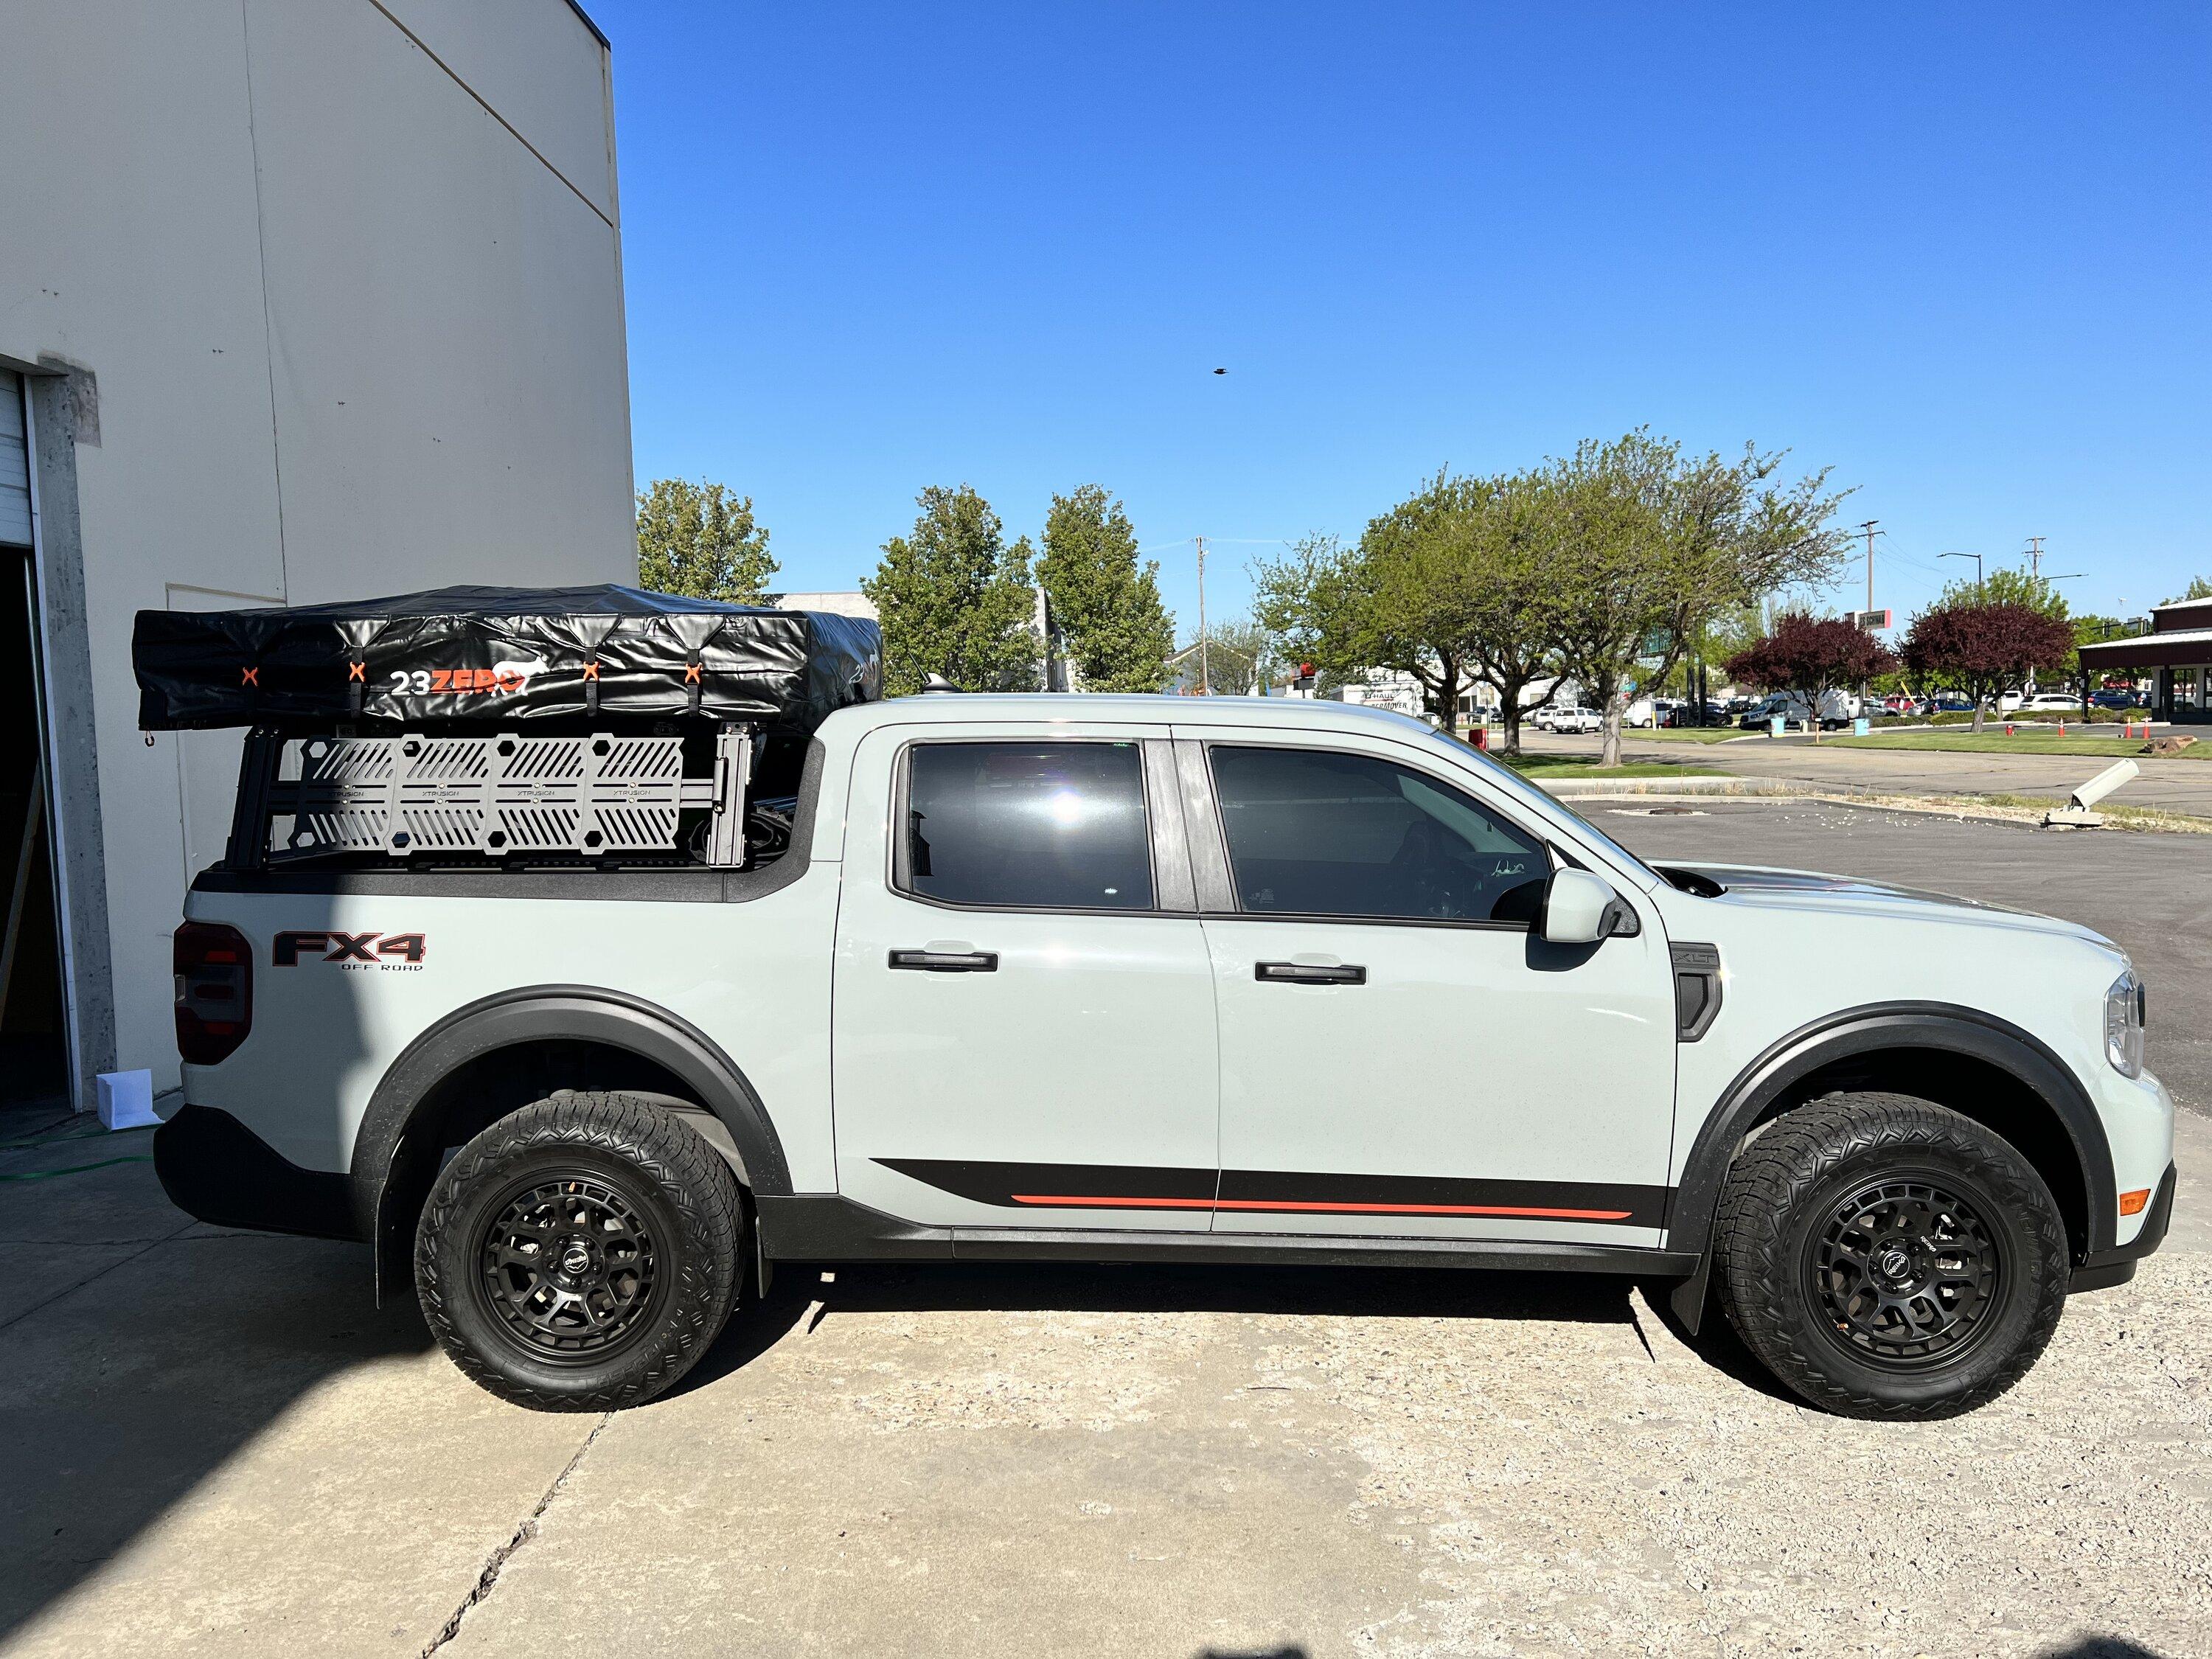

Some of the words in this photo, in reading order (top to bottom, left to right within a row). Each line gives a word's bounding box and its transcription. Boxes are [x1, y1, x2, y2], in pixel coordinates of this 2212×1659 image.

[389, 669, 525, 695] 23ZERO
[272, 931, 426, 967] FX4
[341, 963, 374, 971] OFF
[380, 964, 423, 972] ROAD
[1674, 953, 1716, 964] XLT
